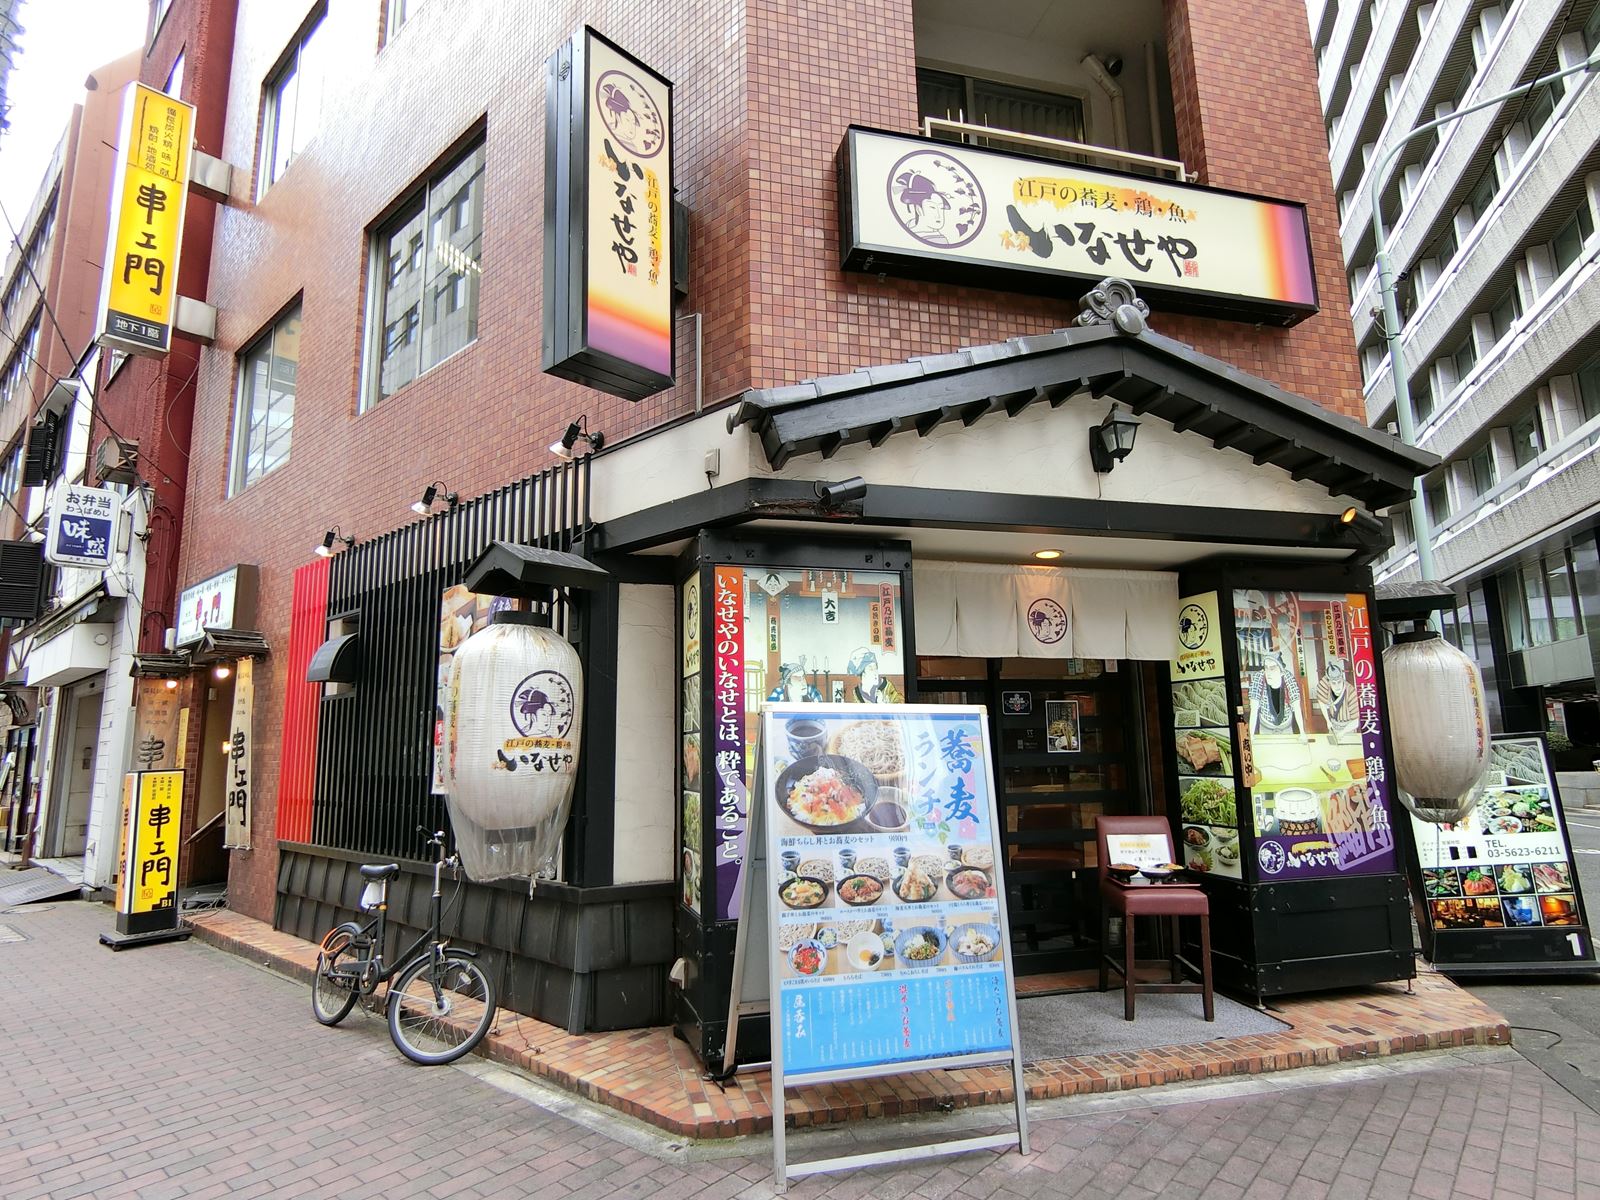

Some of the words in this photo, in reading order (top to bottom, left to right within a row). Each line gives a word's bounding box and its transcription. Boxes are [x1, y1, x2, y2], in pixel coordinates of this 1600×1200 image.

[603, 137, 645, 274] いなせや
[1017, 177, 1188, 224] 江戸の蕎麦・鶏・魚
[1004, 203, 1198, 278] いなせや
[66, 491, 112, 509] お弁当
[824, 598, 836, 622] 大吉
[1348, 605, 1391, 831] 江戸の蕎麦・鶏・魚
[497, 749, 573, 773] いなせや
[914, 731, 941, 817] ランチ
[940, 729, 980, 824] 蕎麦
[1487, 846, 1561, 858] 03-5623-6211
[161, 898, 172, 908] B1
